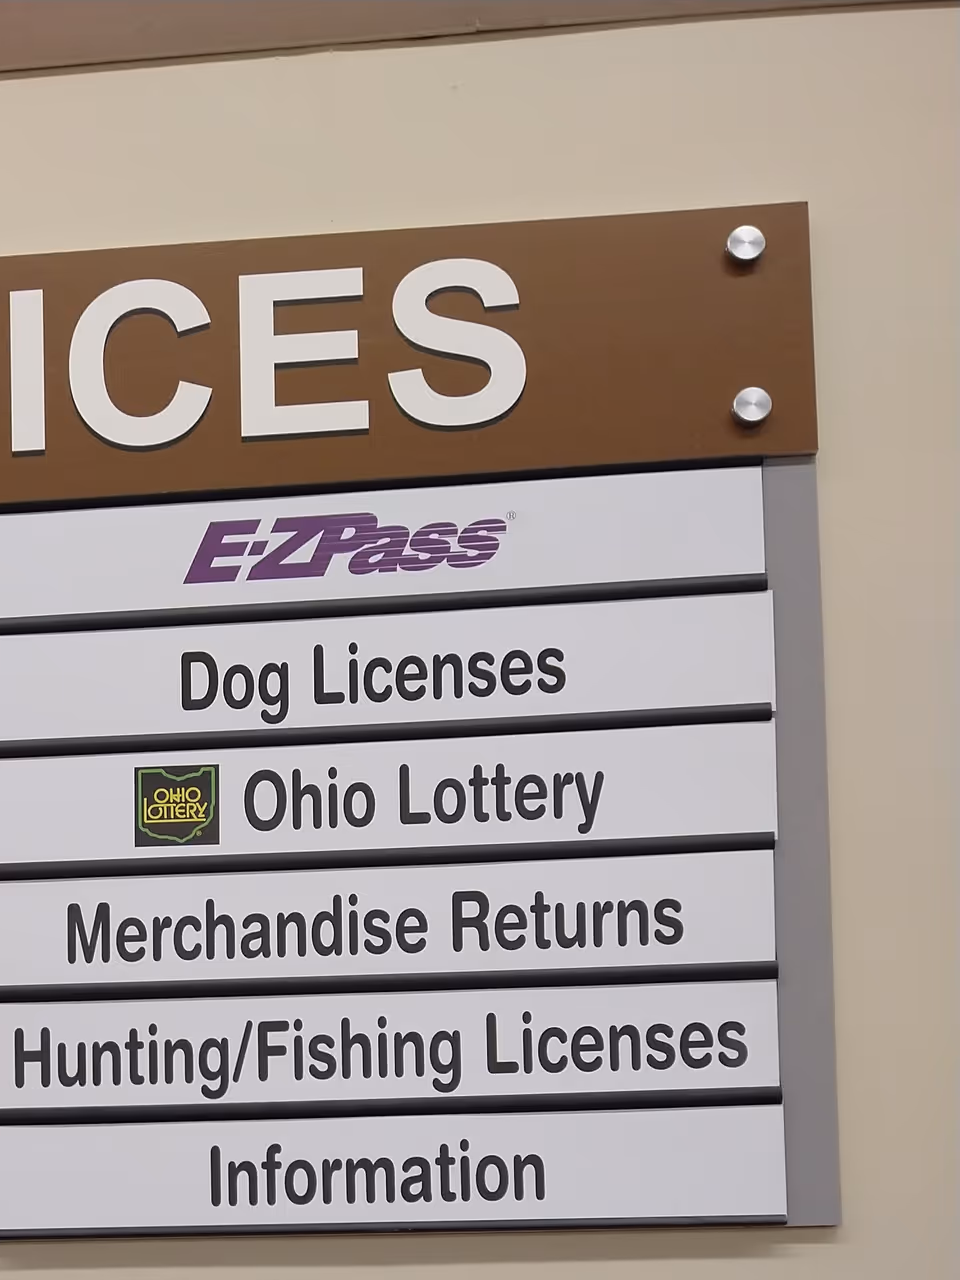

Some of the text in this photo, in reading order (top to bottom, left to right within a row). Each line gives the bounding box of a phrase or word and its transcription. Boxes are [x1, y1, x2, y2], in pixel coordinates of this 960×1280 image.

[183, 512, 507, 584] E-ZPass
[182, 642, 566, 723] Dog Licenses
[144, 798, 207, 823] LOTTERY
[153, 786, 201, 803] OHIO
[243, 762, 605, 834] Ohio Lottery
[66, 890, 684, 964] Merchandise Returns
[14, 1012, 748, 1100] Hunting/Fishing Licenses
[210, 1140, 546, 1207] Information
